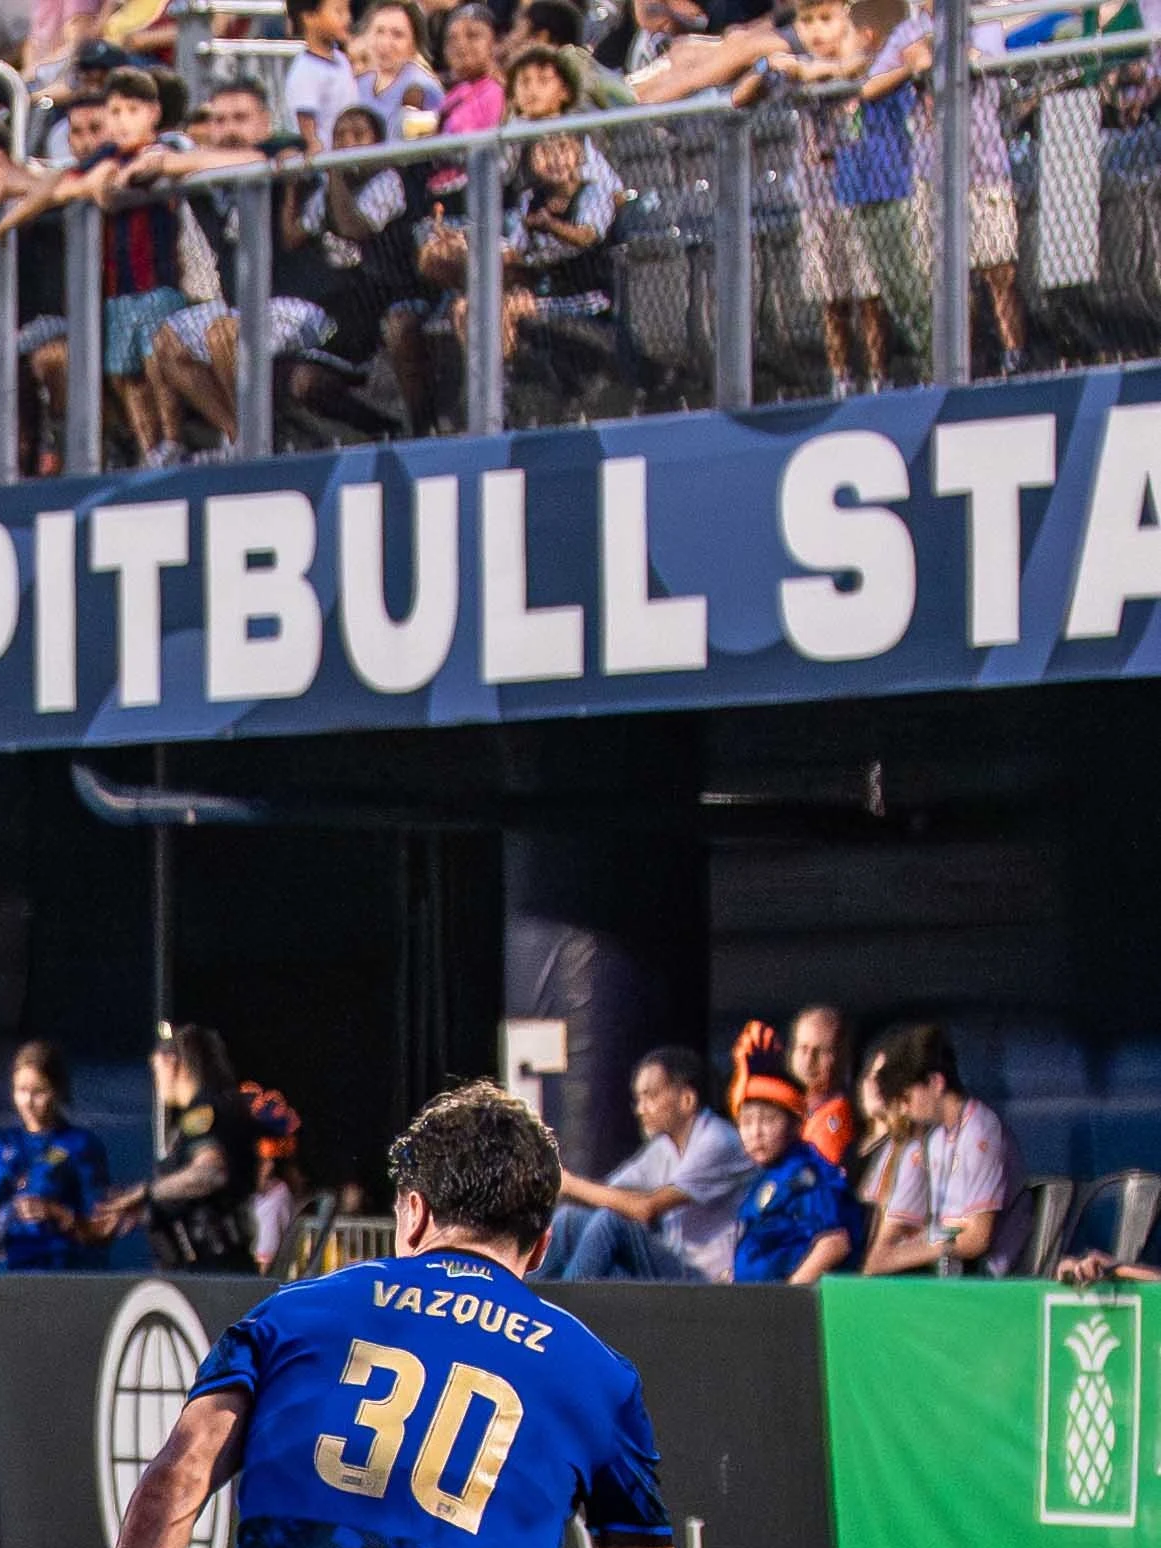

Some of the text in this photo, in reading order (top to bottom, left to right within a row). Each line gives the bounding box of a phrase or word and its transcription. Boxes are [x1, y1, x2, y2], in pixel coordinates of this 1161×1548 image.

[778, 400, 1161, 664] STA
[373, 1280, 553, 1353] VAZQUEZ
[314, 1338, 524, 1535] 30
